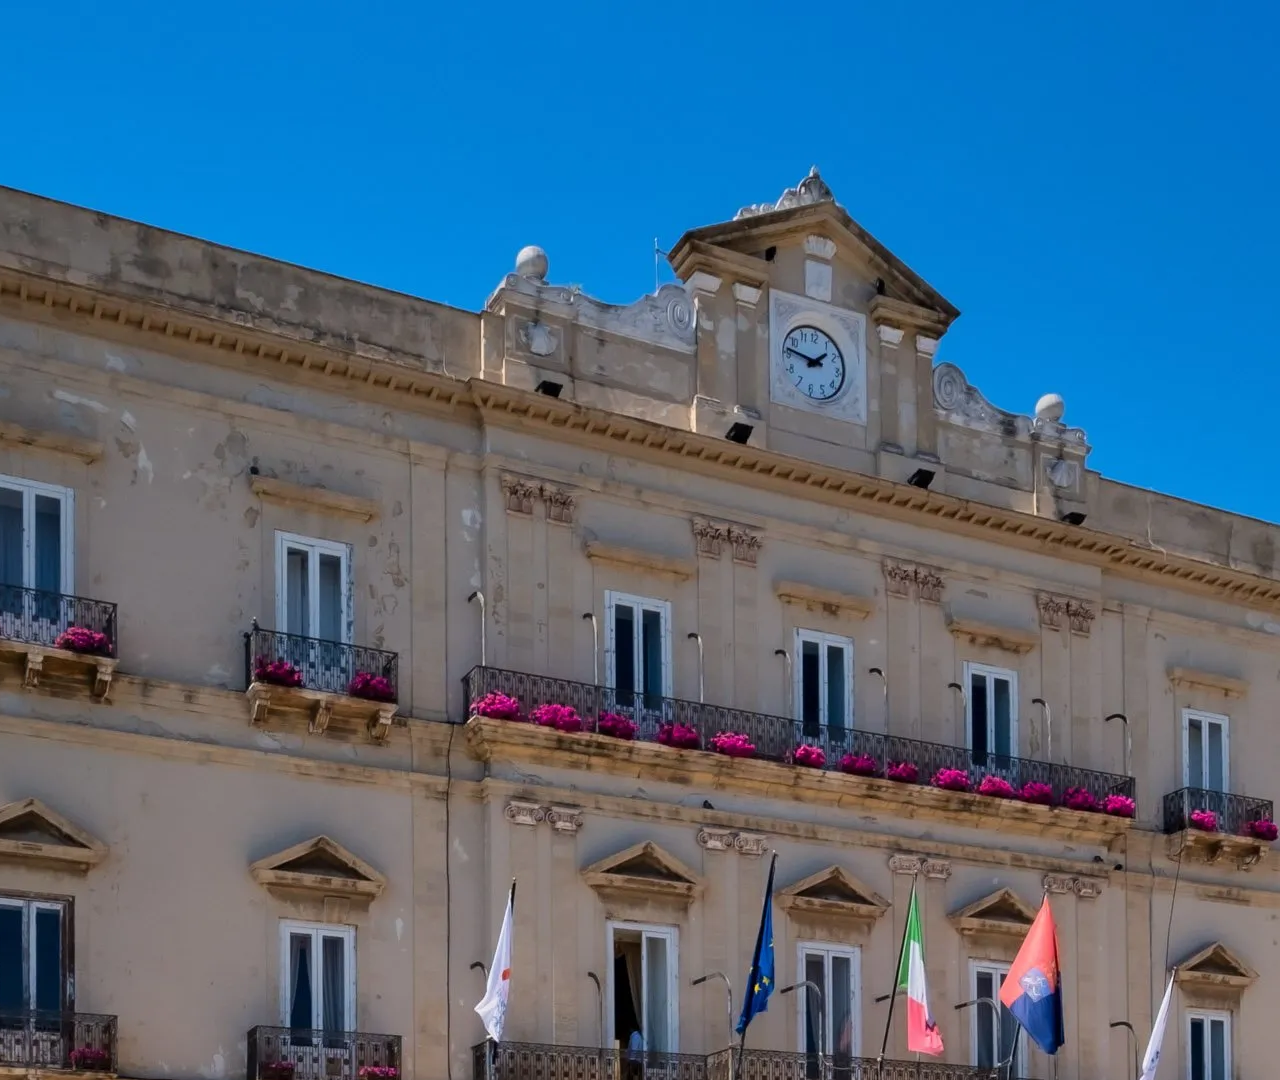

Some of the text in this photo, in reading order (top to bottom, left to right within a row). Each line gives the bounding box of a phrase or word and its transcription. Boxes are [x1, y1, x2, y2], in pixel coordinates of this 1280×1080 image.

[800, 330, 807, 343] 11
[811, 333, 819, 344] 12
[791, 337, 799, 348] 10
[795, 376, 803, 387] 7
